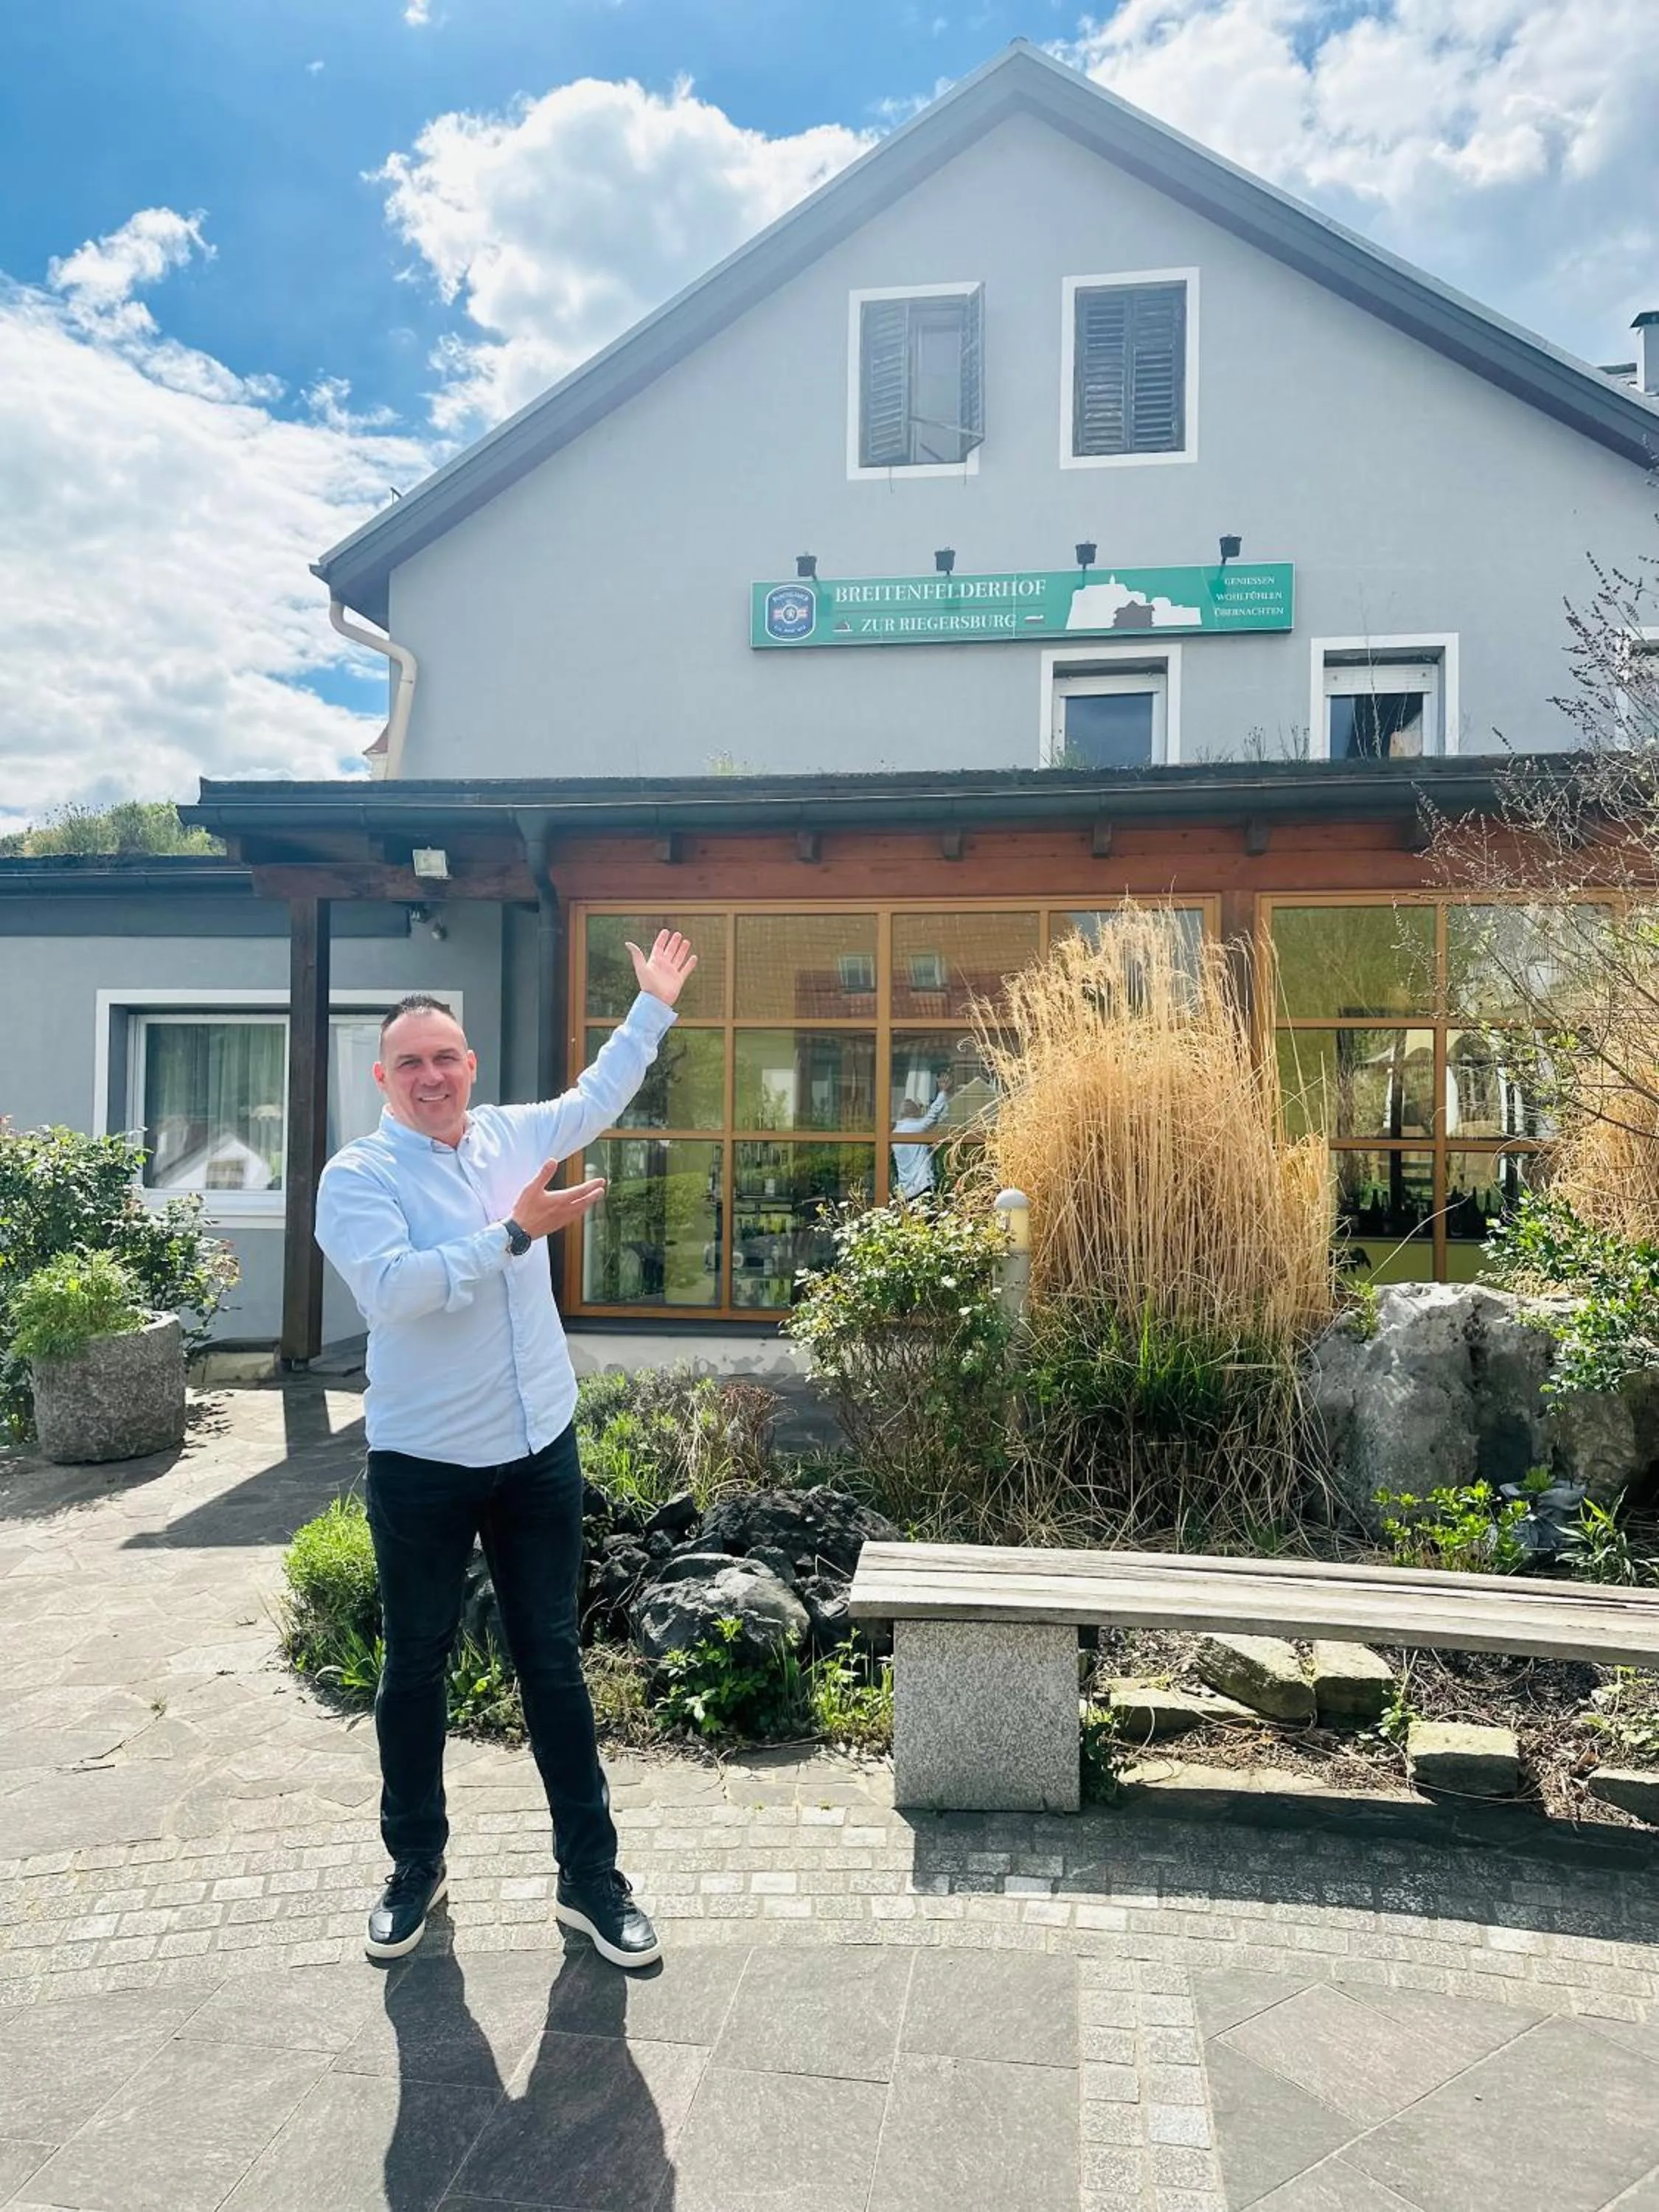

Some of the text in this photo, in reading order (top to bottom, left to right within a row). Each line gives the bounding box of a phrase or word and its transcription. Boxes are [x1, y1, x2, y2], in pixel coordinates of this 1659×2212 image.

[835, 579, 1046, 602] BREITENFELDERHOF
[860, 613, 1017, 633] ZUR RIEGERSBURG
